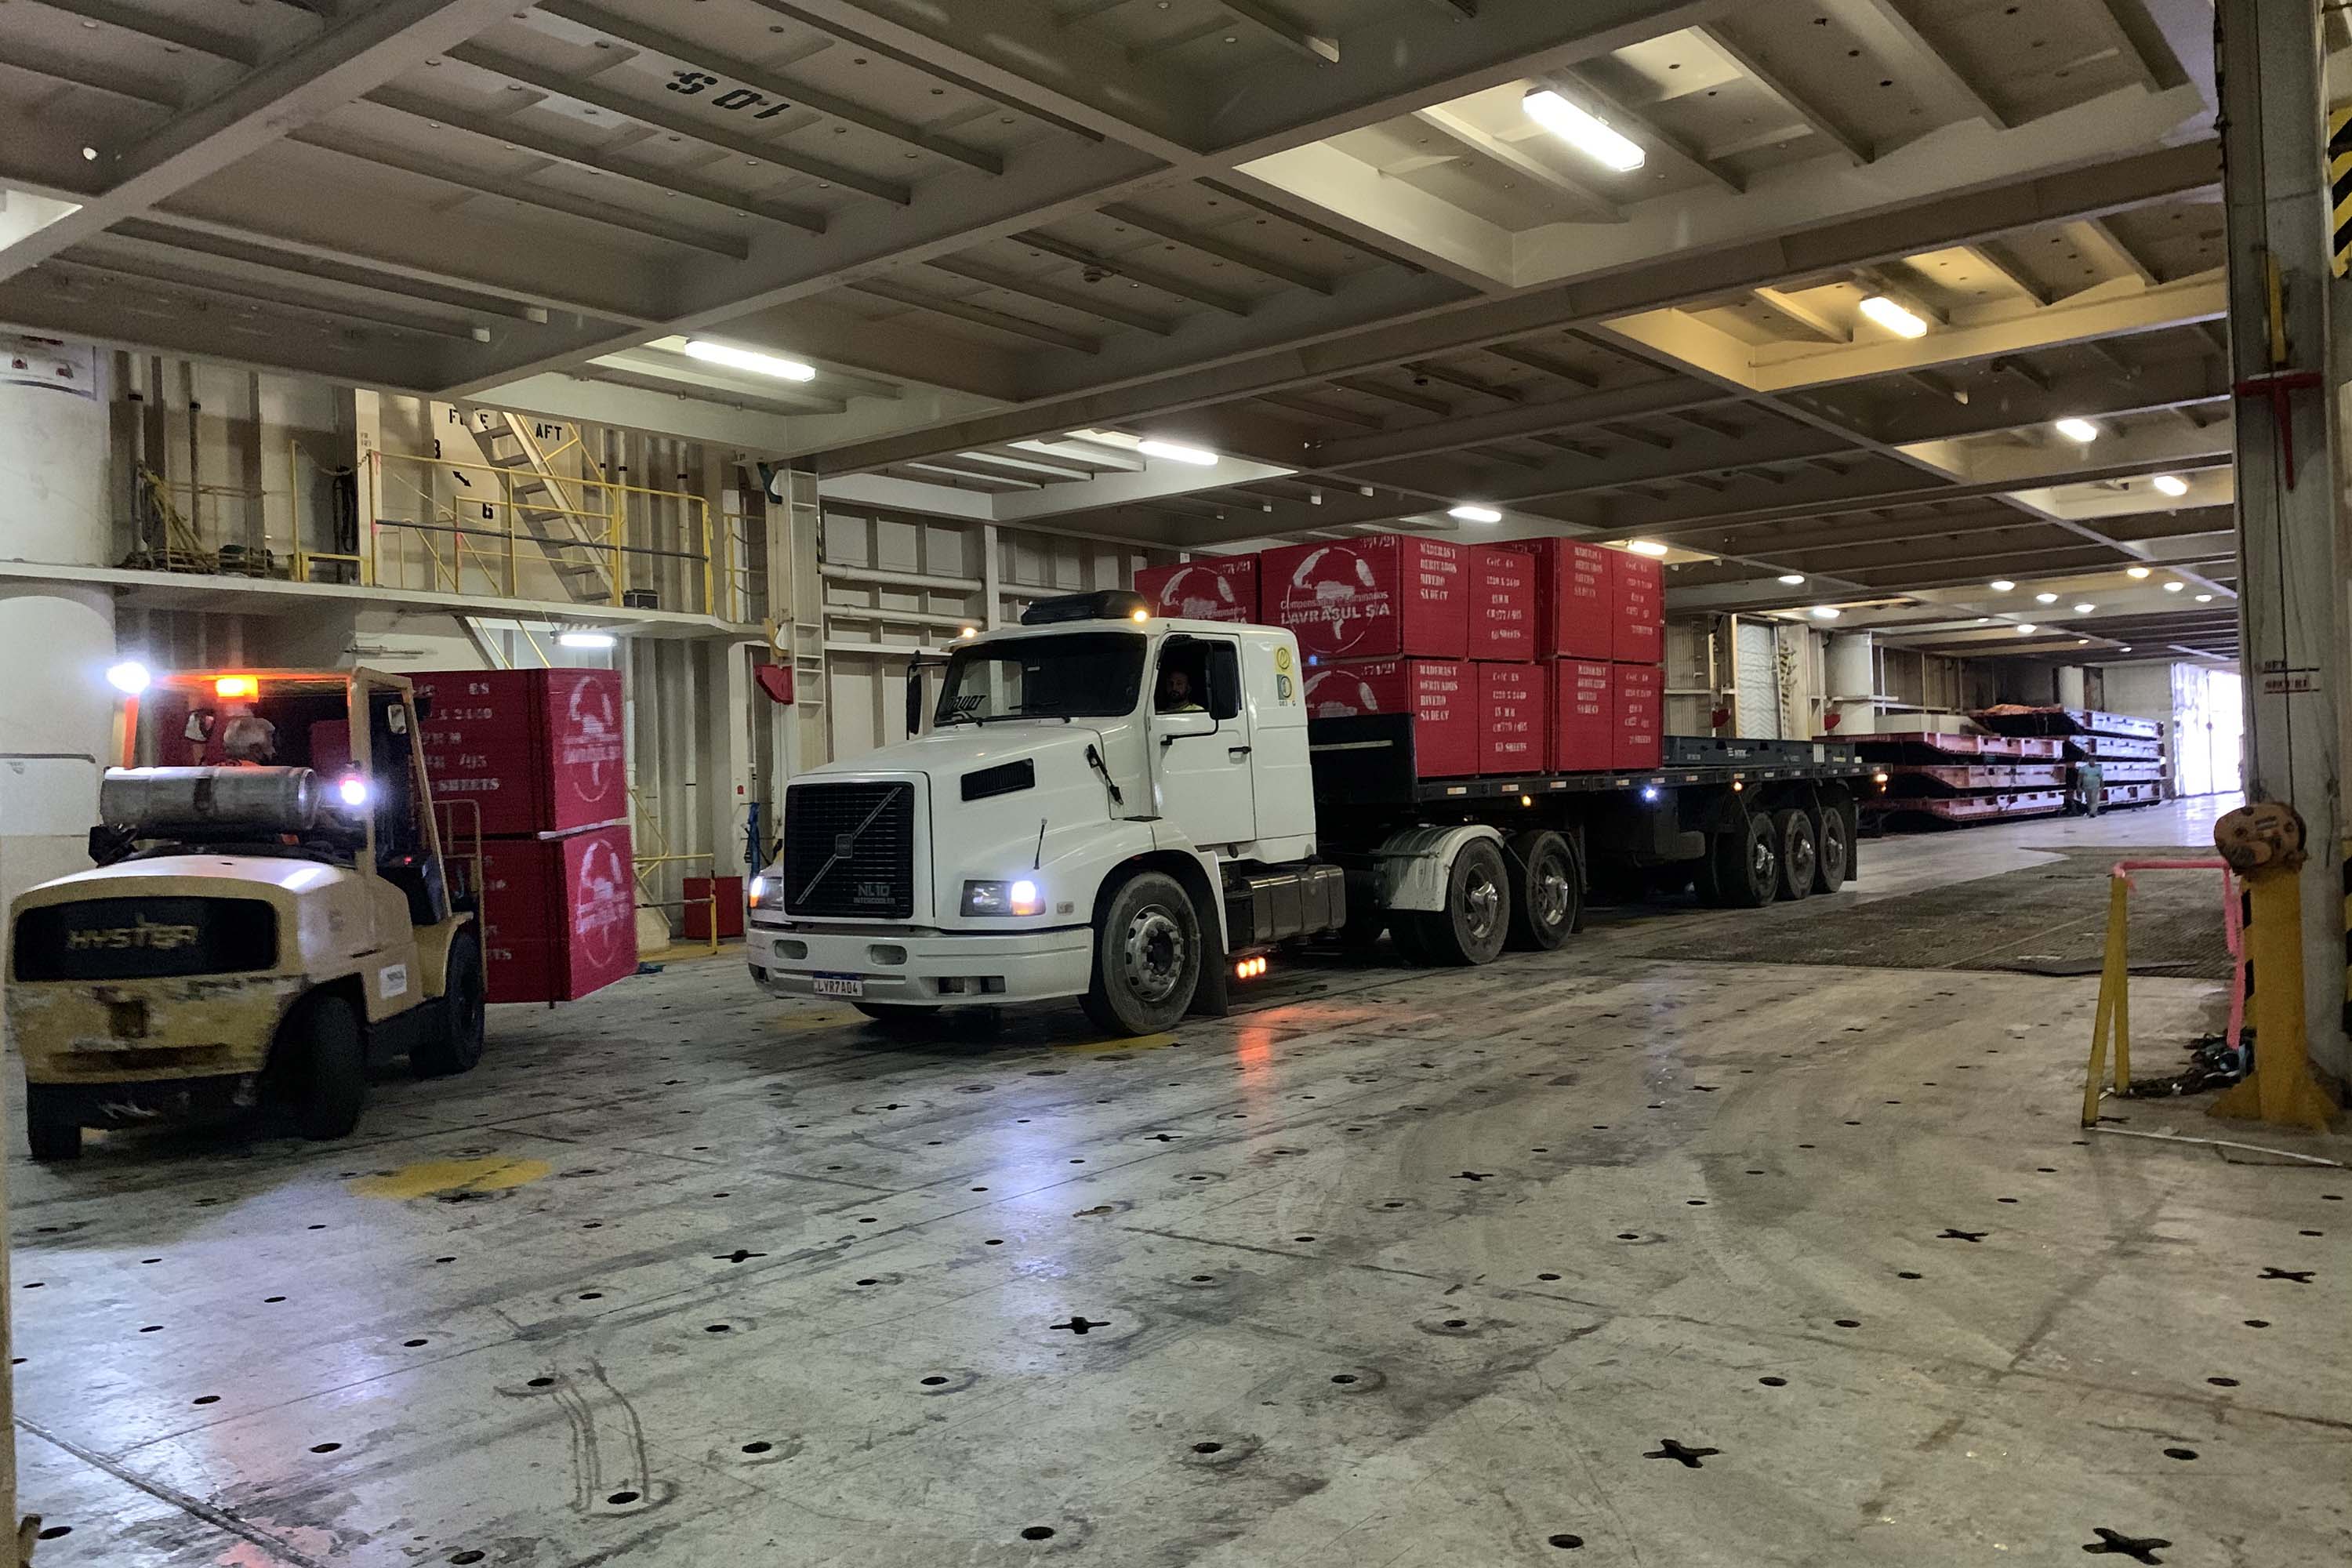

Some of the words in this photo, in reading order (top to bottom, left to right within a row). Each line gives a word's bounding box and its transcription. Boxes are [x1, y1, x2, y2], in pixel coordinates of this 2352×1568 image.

[449, 408, 488, 430] FE
[535, 423, 562, 441] AFT
[1281, 606, 1362, 625] LAVRASUL
